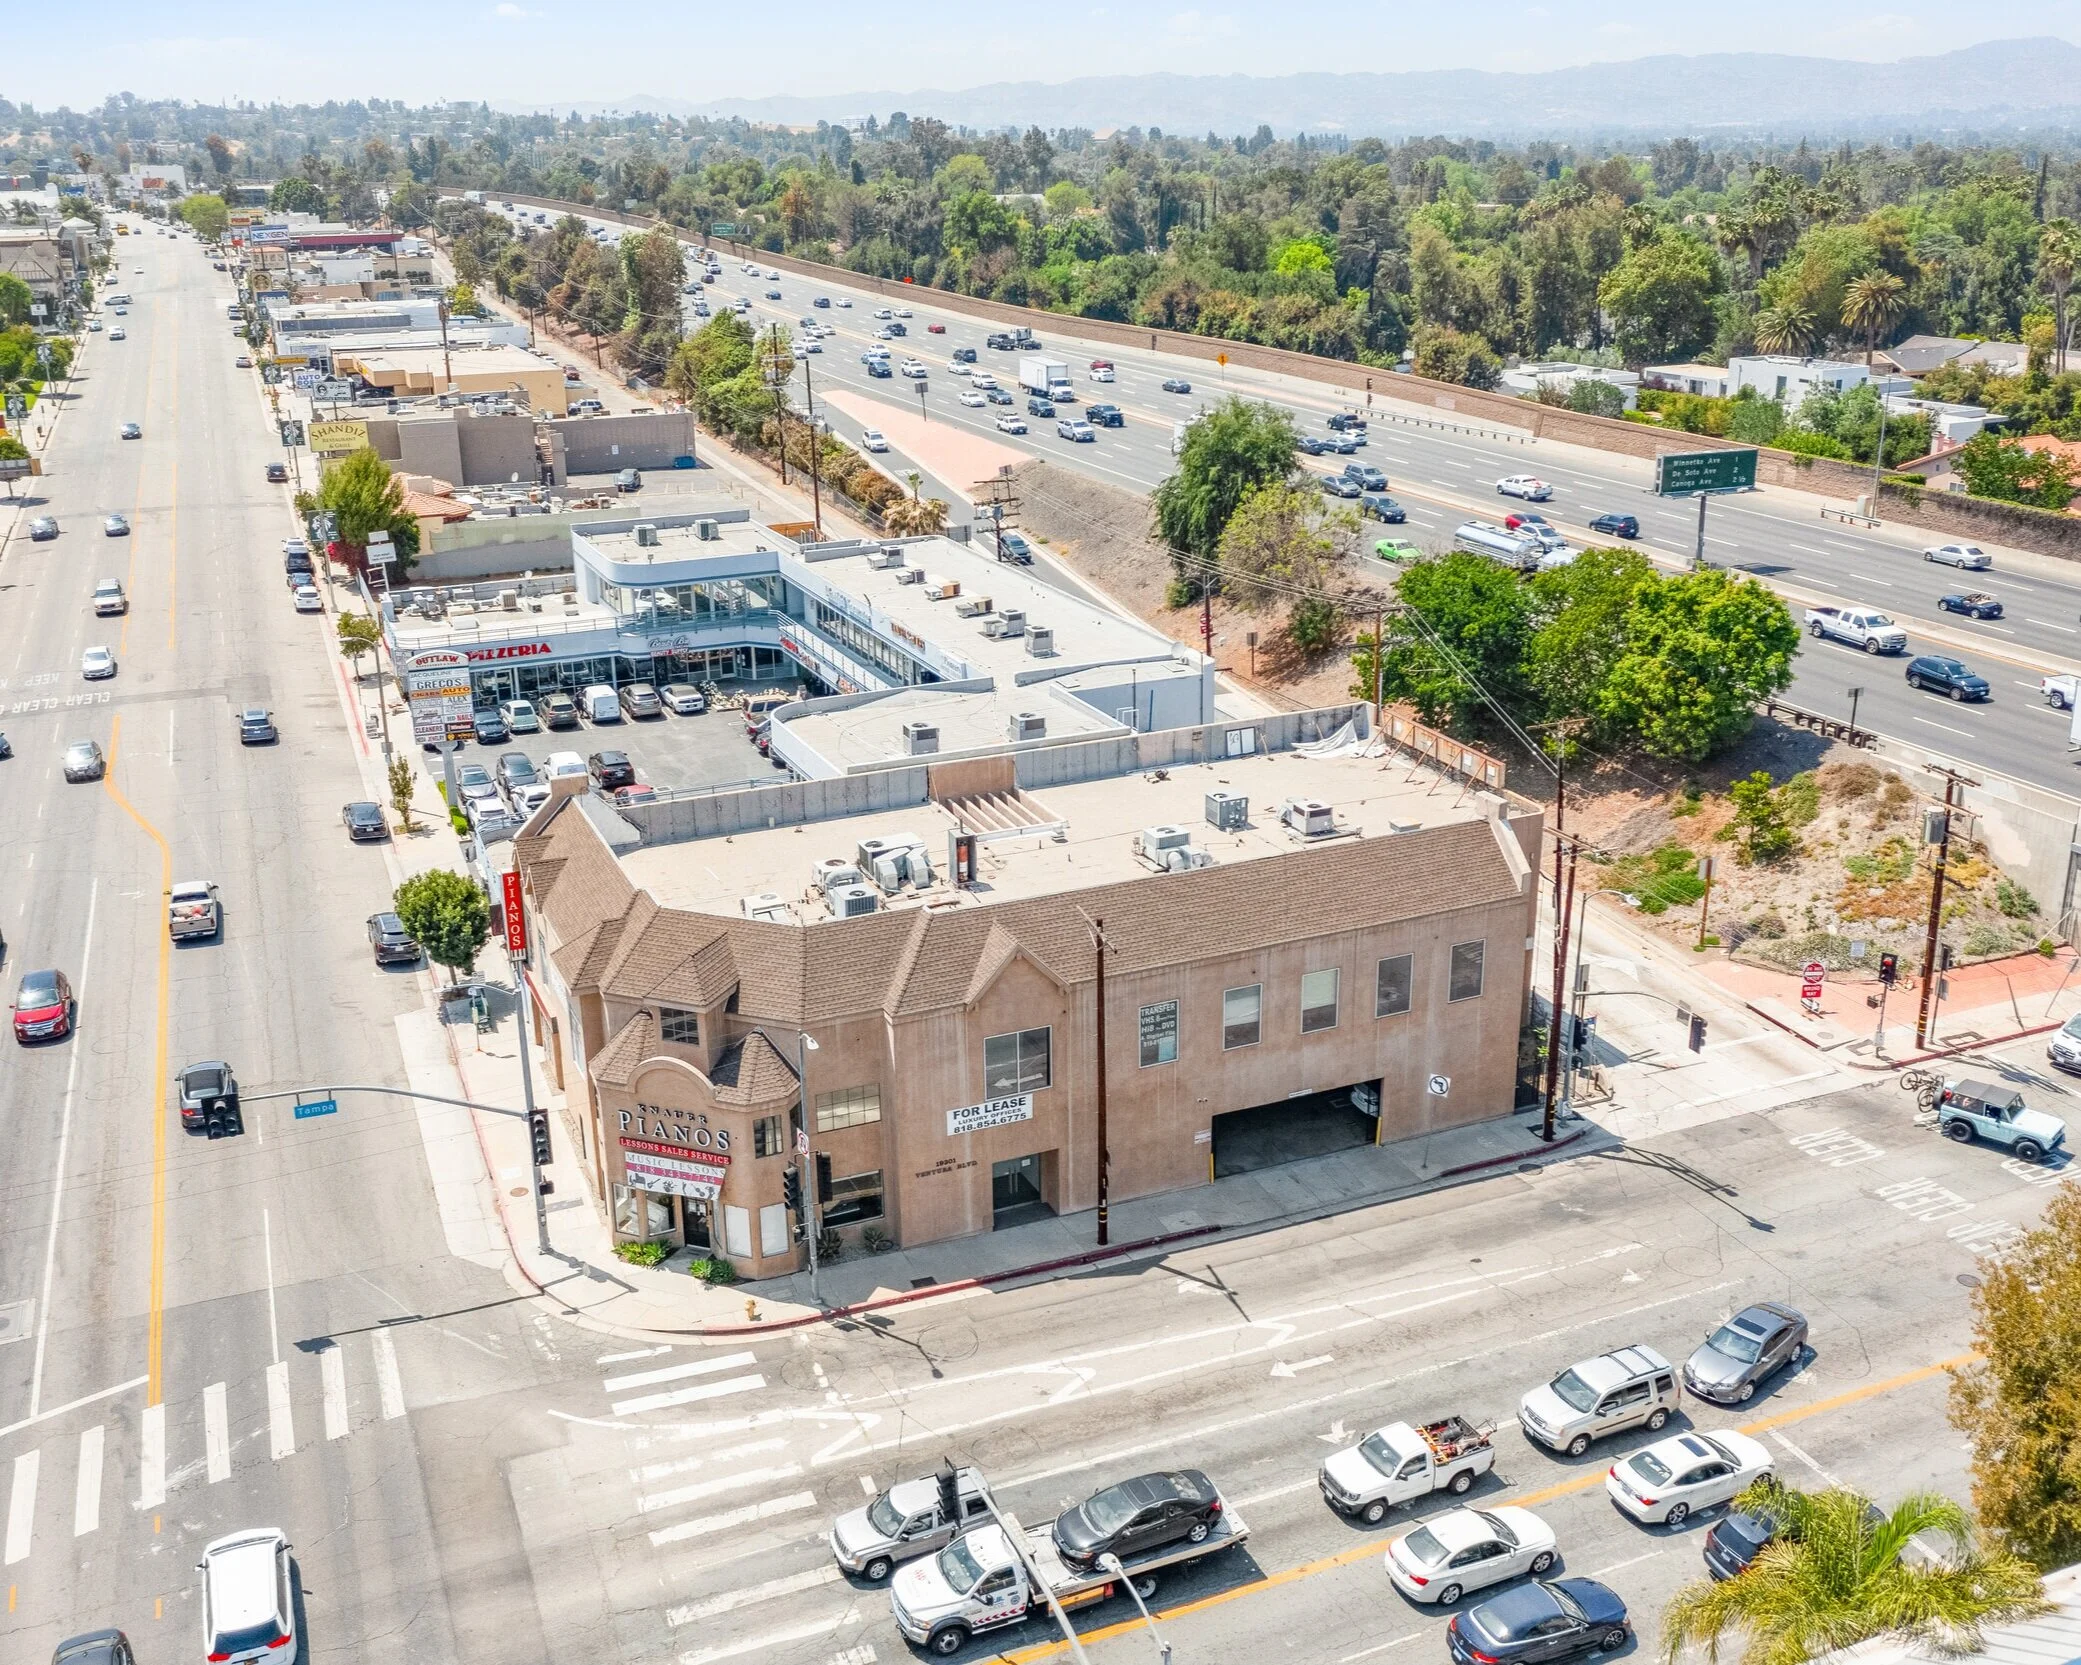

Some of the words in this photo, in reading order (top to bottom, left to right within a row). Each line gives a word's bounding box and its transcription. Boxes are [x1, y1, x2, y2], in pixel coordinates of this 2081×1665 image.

[252, 231, 288, 240] NEXGEN
[311, 425, 366, 440] SHANDIZ
[1673, 459, 1704, 467] Winnetka
[1671, 479, 1695, 488] Canoga
[465, 642, 552, 661] PIZZERIA
[415, 655, 459, 665] OUTLAW
[25, 672, 60, 686] KEEP
[442, 686, 470, 694] AUTO
[12, 697, 59, 713] CLEAR
[66, 691, 111, 706] CLEAR
[456, 713, 474, 721] NAILS
[415, 725, 443, 733] CLEANERS
[507, 876, 521, 946] PIANOS
[1141, 1003, 1176, 1017] TRANSFER
[1161, 1020, 1175, 1030] DVD
[297, 1105, 334, 1115] Tampa
[637, 1103, 708, 1124] KNAUER
[953, 1106, 980, 1120] FOR
[984, 1097, 1026, 1114] LEASE
[954, 1112, 1026, 1134] 818.854.6775
[958, 1114, 988, 1125] LUXURY
[991, 1108, 1022, 1118] OFFICES
[618, 1109, 730, 1151] PIANOS
[620, 1138, 660, 1152] LESSONS
[661, 1145, 689, 1157] SALES
[690, 1151, 730, 1165] SERVICE
[1789, 1127, 1886, 1168] CLEAR
[626, 1153, 666, 1166] MUSIC
[671, 1160, 725, 1178] LESSONS
[915, 1166, 953, 1178] VENTURA
[956, 1160, 978, 1170] BLVD
[1875, 1177, 1976, 1222] CLEAR
